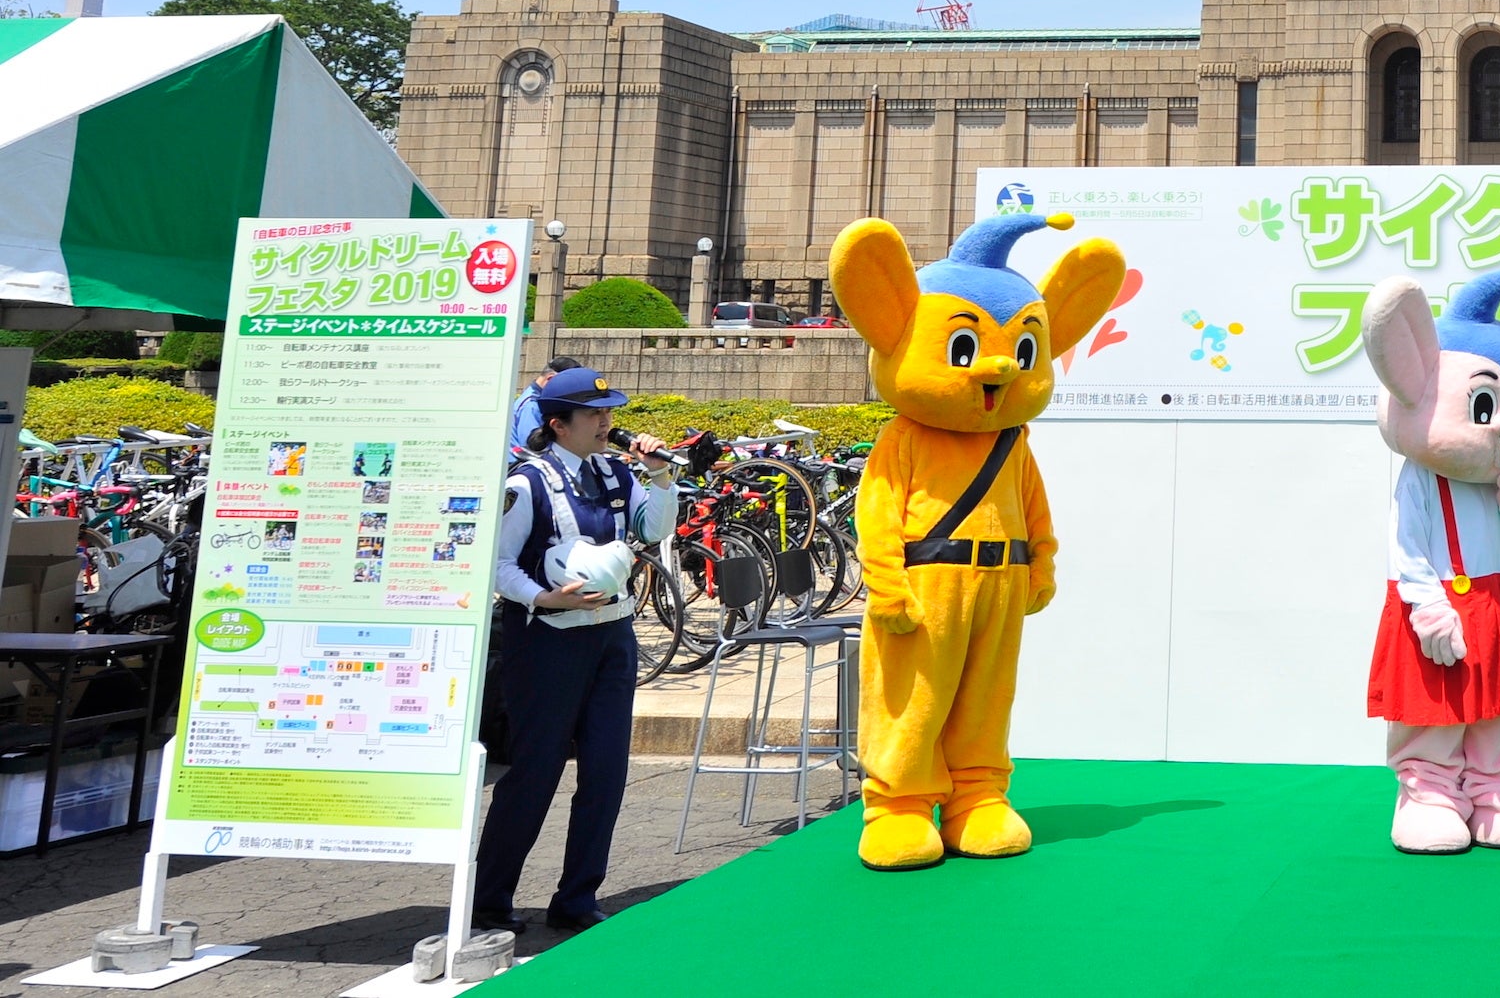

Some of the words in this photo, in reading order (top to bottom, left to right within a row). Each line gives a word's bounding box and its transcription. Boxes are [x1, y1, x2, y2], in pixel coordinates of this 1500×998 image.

[252, 222, 352, 240] 「自転車の日」記念行事
[250, 230, 472, 279] サイクルドリーム
[474, 247, 509, 266] 入場
[472, 268, 507, 286] 無料
[247, 275, 361, 316] フェスタ
[368, 267, 459, 306] 2019
[439, 304, 464, 314] 10:00
[482, 303, 507, 314] 16:00
[229, 430, 290, 439] ステージイベント
[207, 625, 251, 634] レイアウト
[239, 837, 314, 851] 競輪の補助事業
